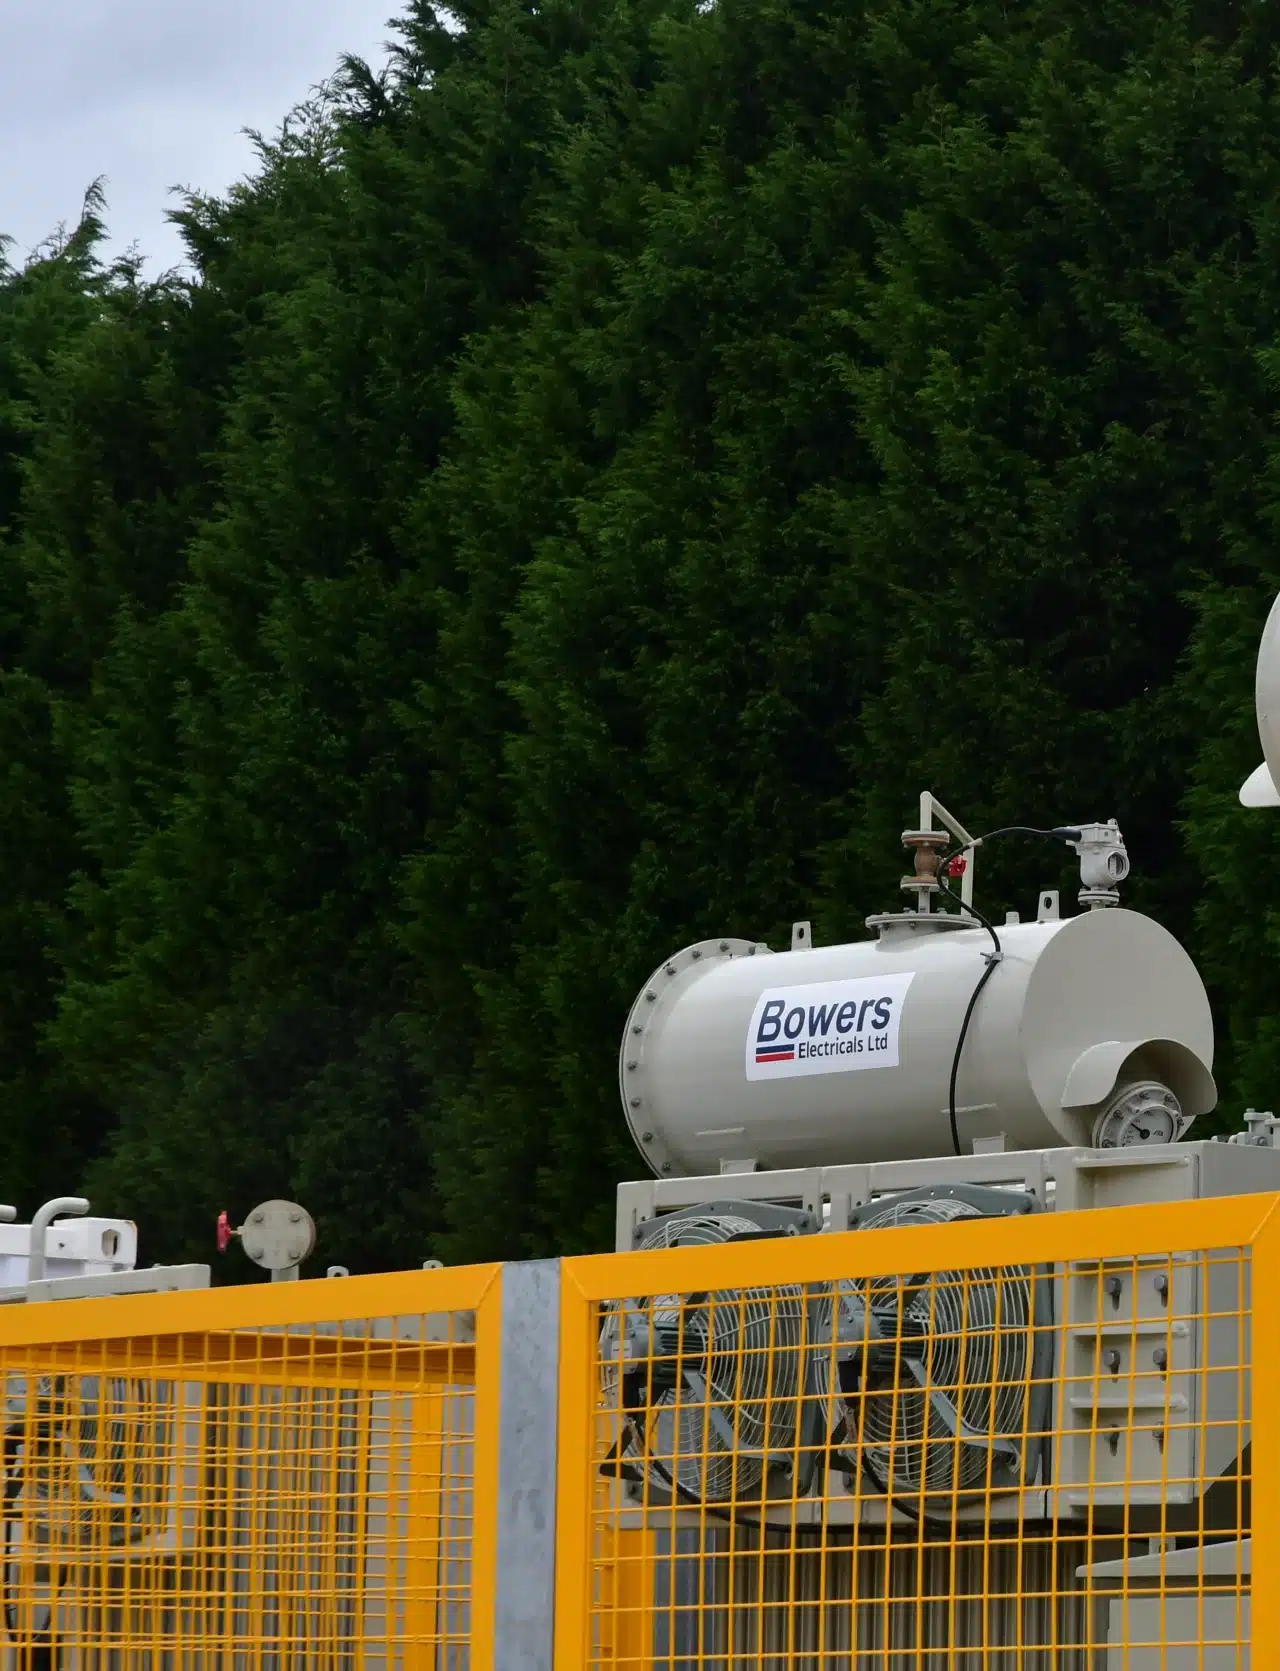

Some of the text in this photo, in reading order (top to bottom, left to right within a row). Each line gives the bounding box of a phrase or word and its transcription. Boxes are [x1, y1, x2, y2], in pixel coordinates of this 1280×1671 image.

[757, 996, 893, 1043] Bowers
[798, 1033, 888, 1059] Electricals Ltd
